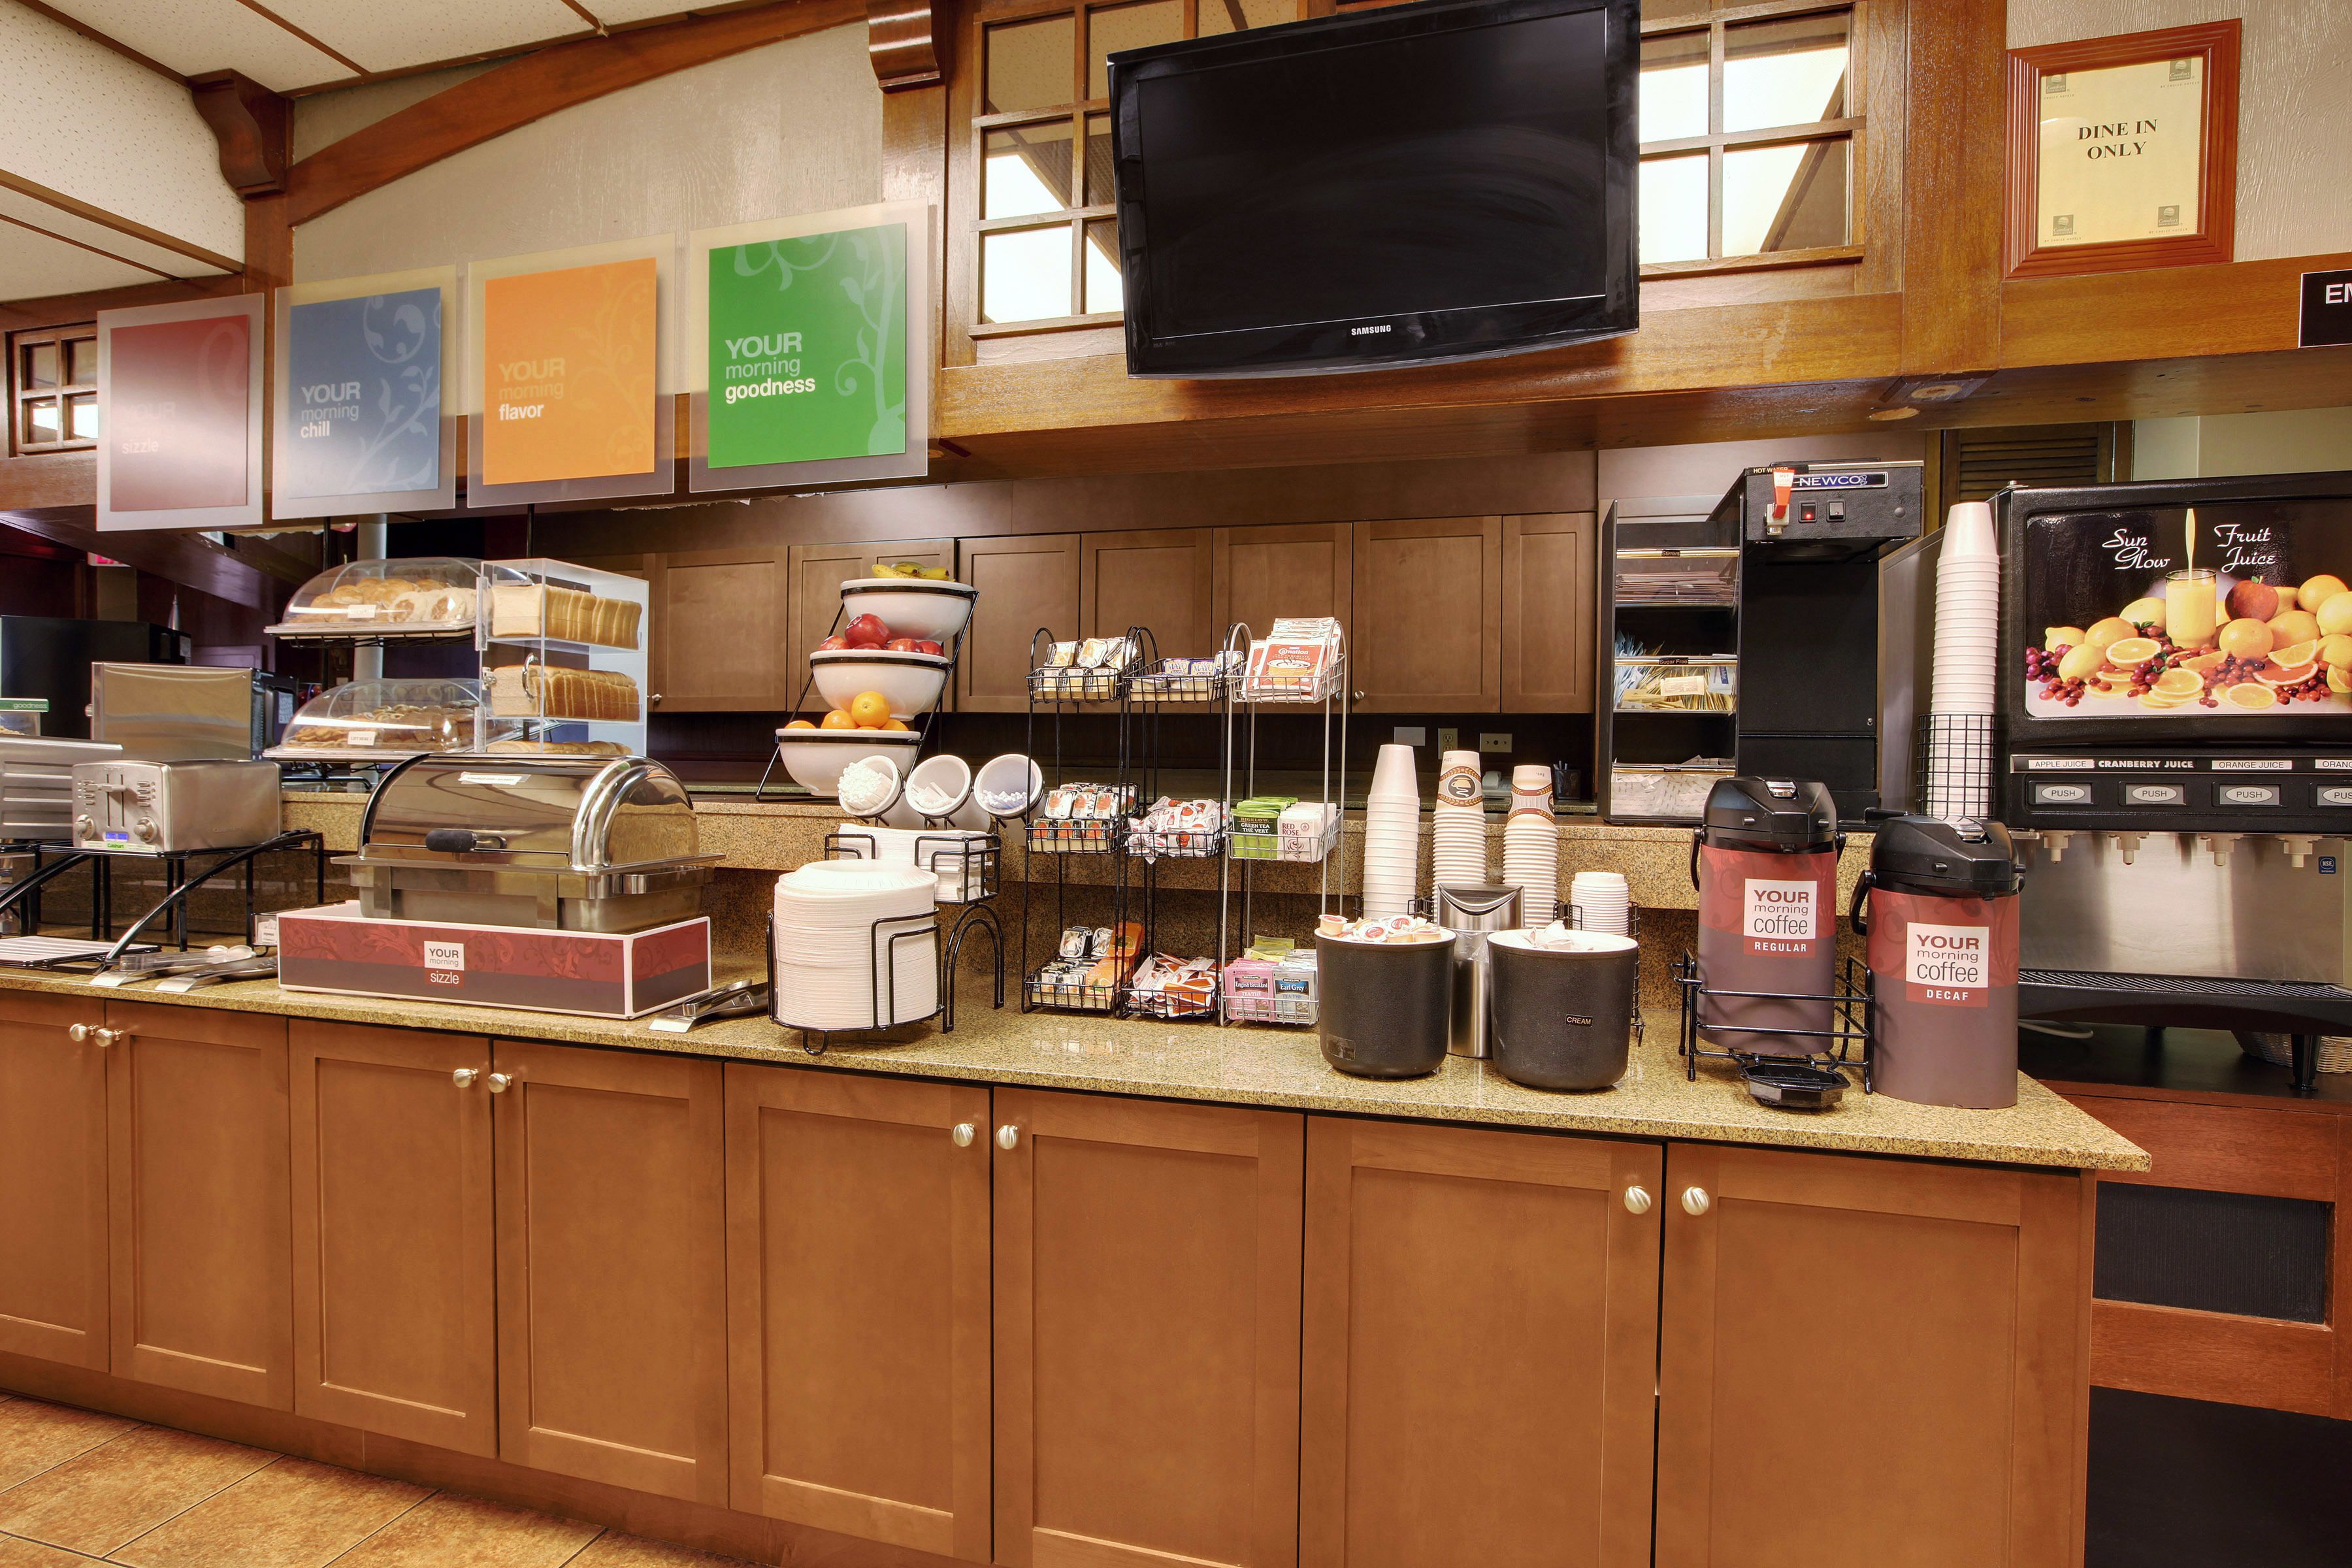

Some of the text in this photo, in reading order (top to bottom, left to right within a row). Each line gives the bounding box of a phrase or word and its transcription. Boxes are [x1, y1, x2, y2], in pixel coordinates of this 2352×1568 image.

[2078, 119, 2158, 140] DINE IN
[2087, 141, 2147, 159] ONLY
[1351, 325, 1392, 336] SAMSUNG
[725, 332, 802, 359] YOUR
[499, 357, 565, 382] YOUR
[726, 357, 800, 379] morning
[301, 381, 361, 404] YOUR
[498, 381, 564, 400] morning
[725, 378, 815, 404] goodness
[122, 400, 176, 420] OUR
[301, 402, 359, 421] morning
[498, 403, 544, 421] flavor
[301, 420, 330, 438] chill
[122, 438, 159, 454] sizzle
[1799, 476, 1861, 487] NEWCO
[2102, 529, 2148, 548] Sun
[2214, 524, 2272, 547] Fruit
[2115, 546, 2170, 570] Glow
[2221, 546, 2276, 573] Juice
[1754, 889, 1809, 904] YOUR
[1754, 904, 1808, 916] morning
[1754, 915, 1808, 935] coffee
[1754, 941, 1806, 952] REGULAR
[1916, 934, 1980, 950] YOUR
[429, 948, 459, 958] YOUR
[1917, 950, 1978, 963] morning
[429, 958, 459, 968] morning
[1917, 961, 1978, 983] coffee
[430, 970, 459, 985] sizzle
[1926, 989, 1968, 1001] DECAF
[1567, 1017, 1592, 1025] CREAM
